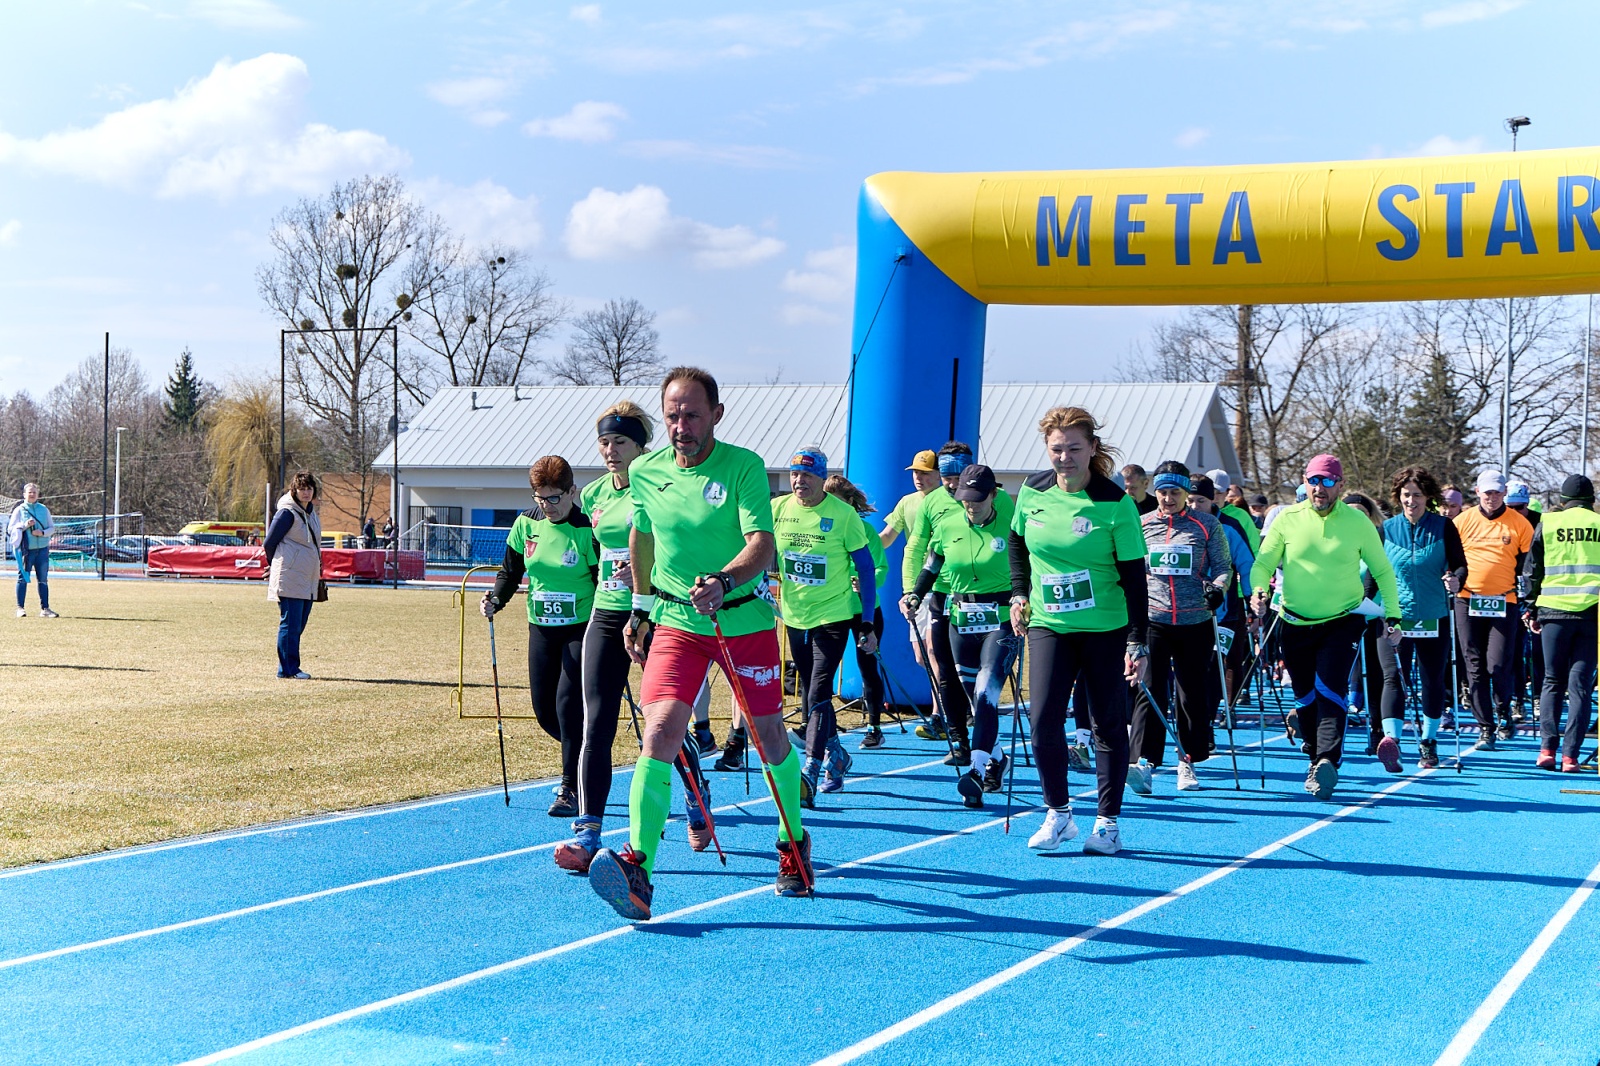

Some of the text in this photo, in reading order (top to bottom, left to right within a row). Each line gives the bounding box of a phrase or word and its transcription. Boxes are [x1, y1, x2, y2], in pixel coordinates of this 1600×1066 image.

[1036, 191, 1262, 266] META
[1159, 552, 1179, 565] 40
[794, 561, 813, 575] 68
[1052, 583, 1075, 599] 91
[543, 602, 563, 614] 56
[1475, 599, 1500, 609] 120
[966, 612, 986, 623] 59
